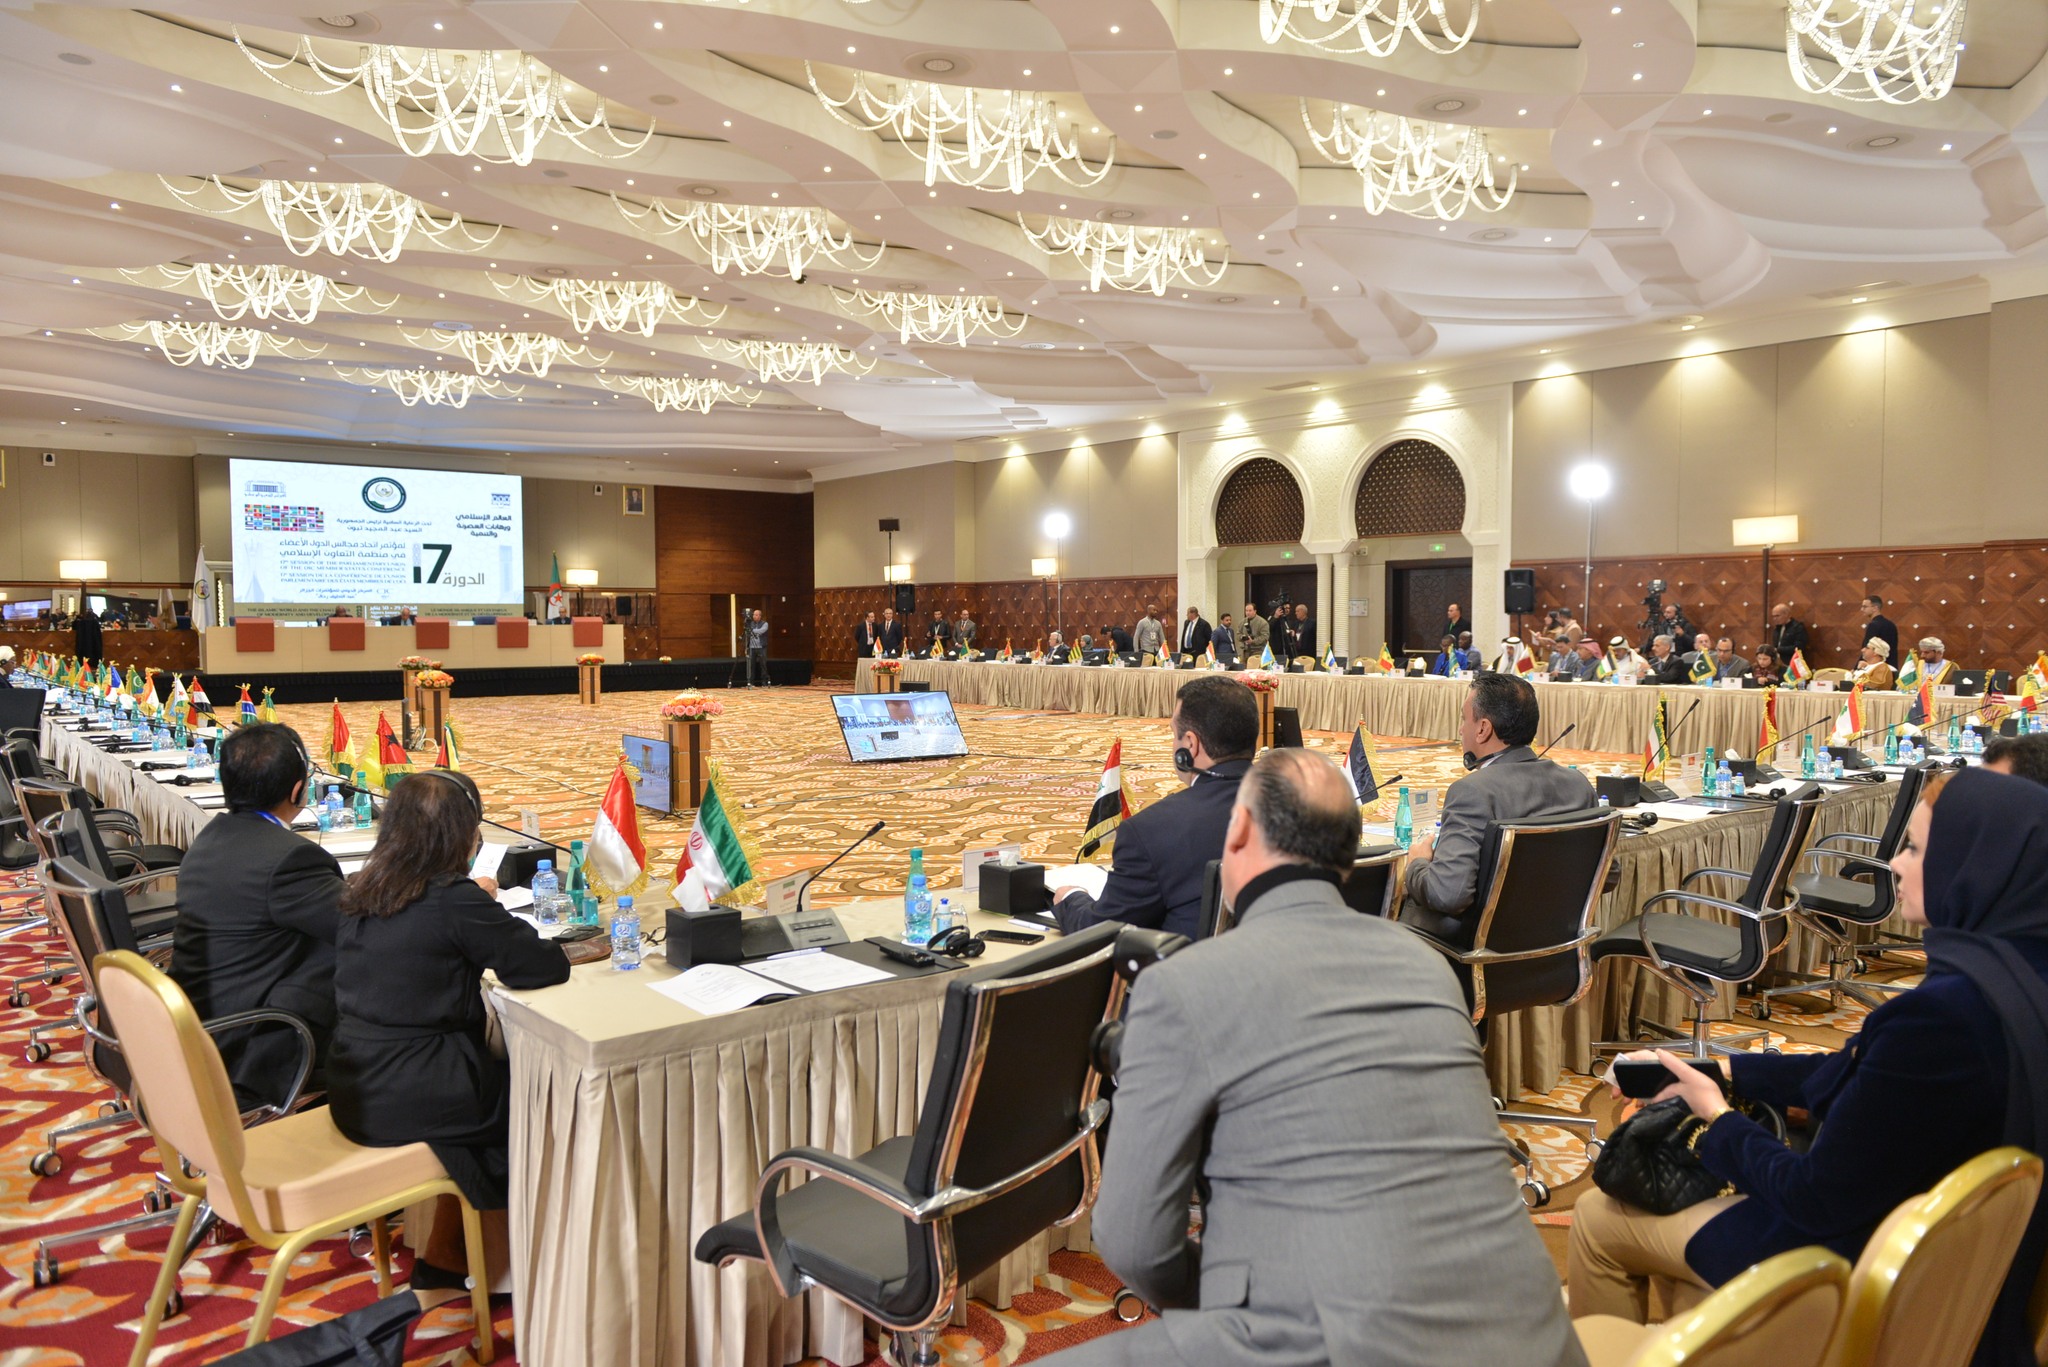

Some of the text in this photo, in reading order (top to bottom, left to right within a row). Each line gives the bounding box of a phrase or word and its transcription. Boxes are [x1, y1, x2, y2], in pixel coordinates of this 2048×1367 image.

[485, 524, 511, 532] ورهانات
[280, 536, 406, 550] لمؤتمر اتحاد مجالس الدول الأعضاء
[280, 548, 321, 559] الإسلامي
[324, 549, 355, 559] التعاون
[358, 550, 388, 558] منظمة
[413, 543, 485, 587] الدورة 17
